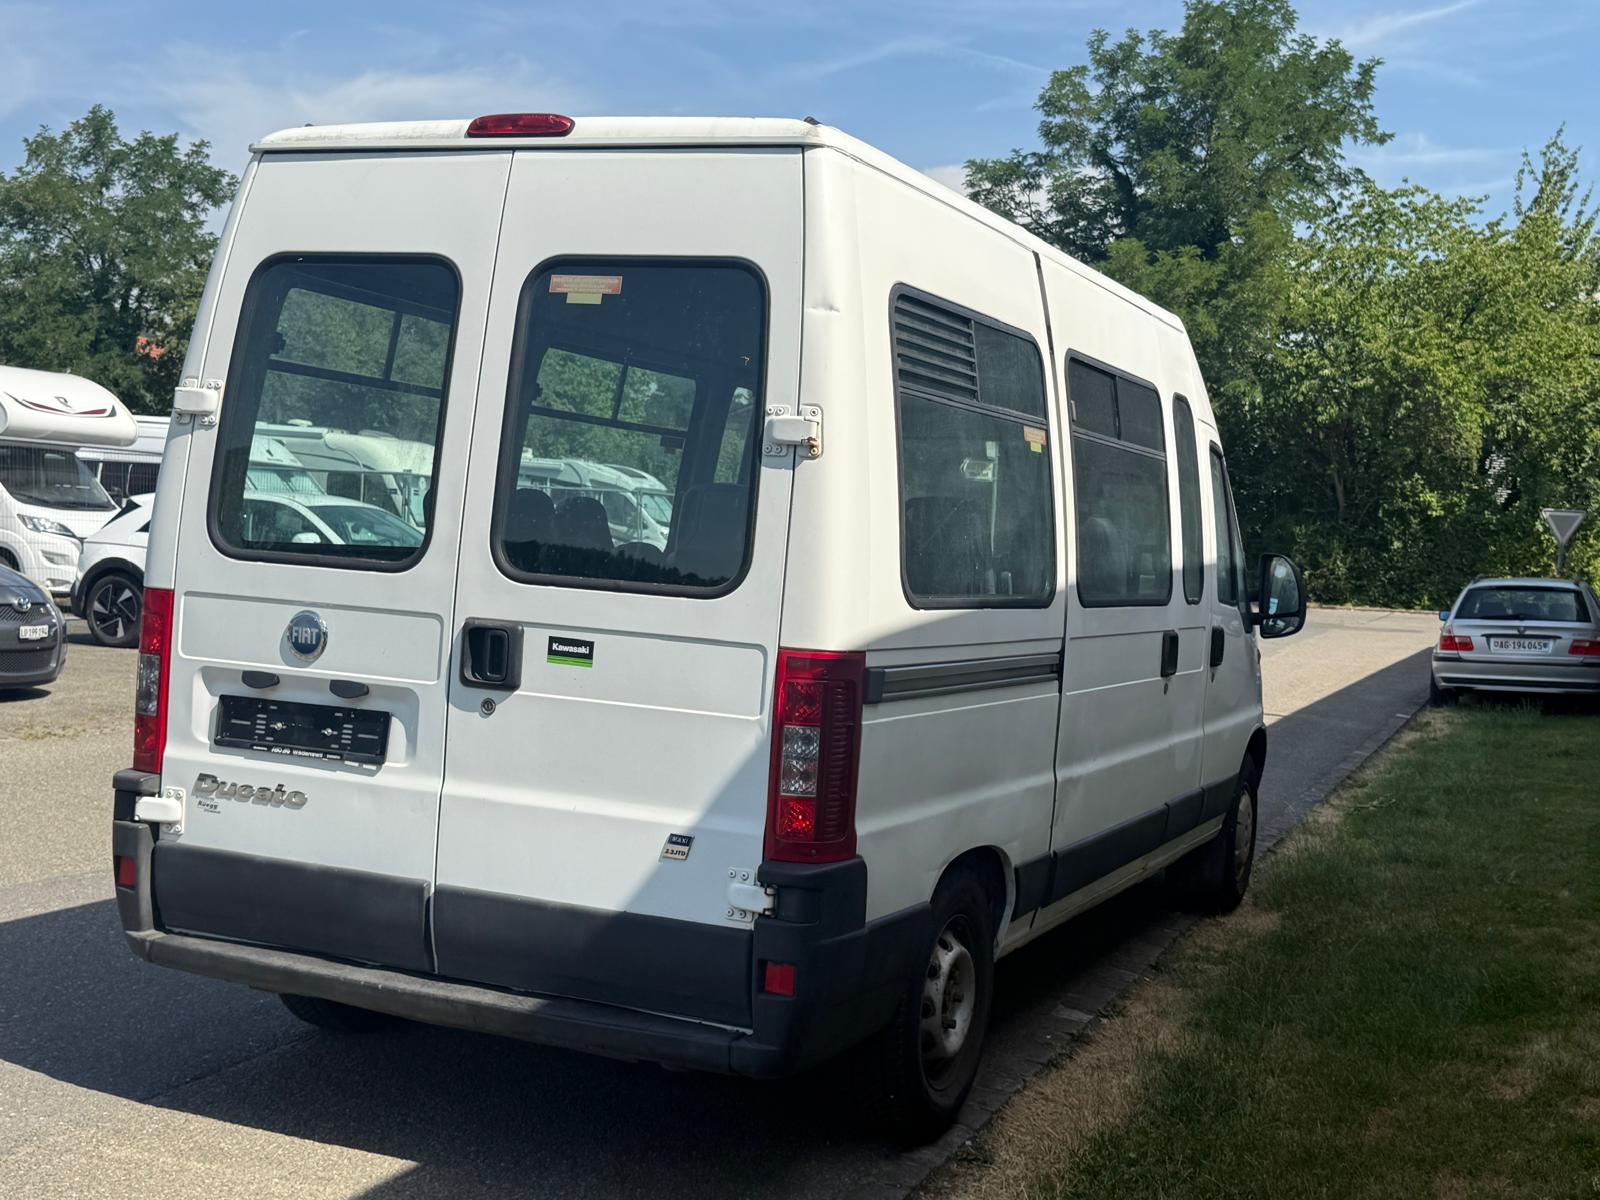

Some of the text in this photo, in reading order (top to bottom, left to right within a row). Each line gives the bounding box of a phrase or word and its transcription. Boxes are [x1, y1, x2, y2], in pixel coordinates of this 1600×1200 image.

[292, 626, 319, 645] FIAT
[552, 642, 590, 654] Kawasaki
[192, 772, 308, 808] Ducato
[671, 835, 689, 844] MAXI
